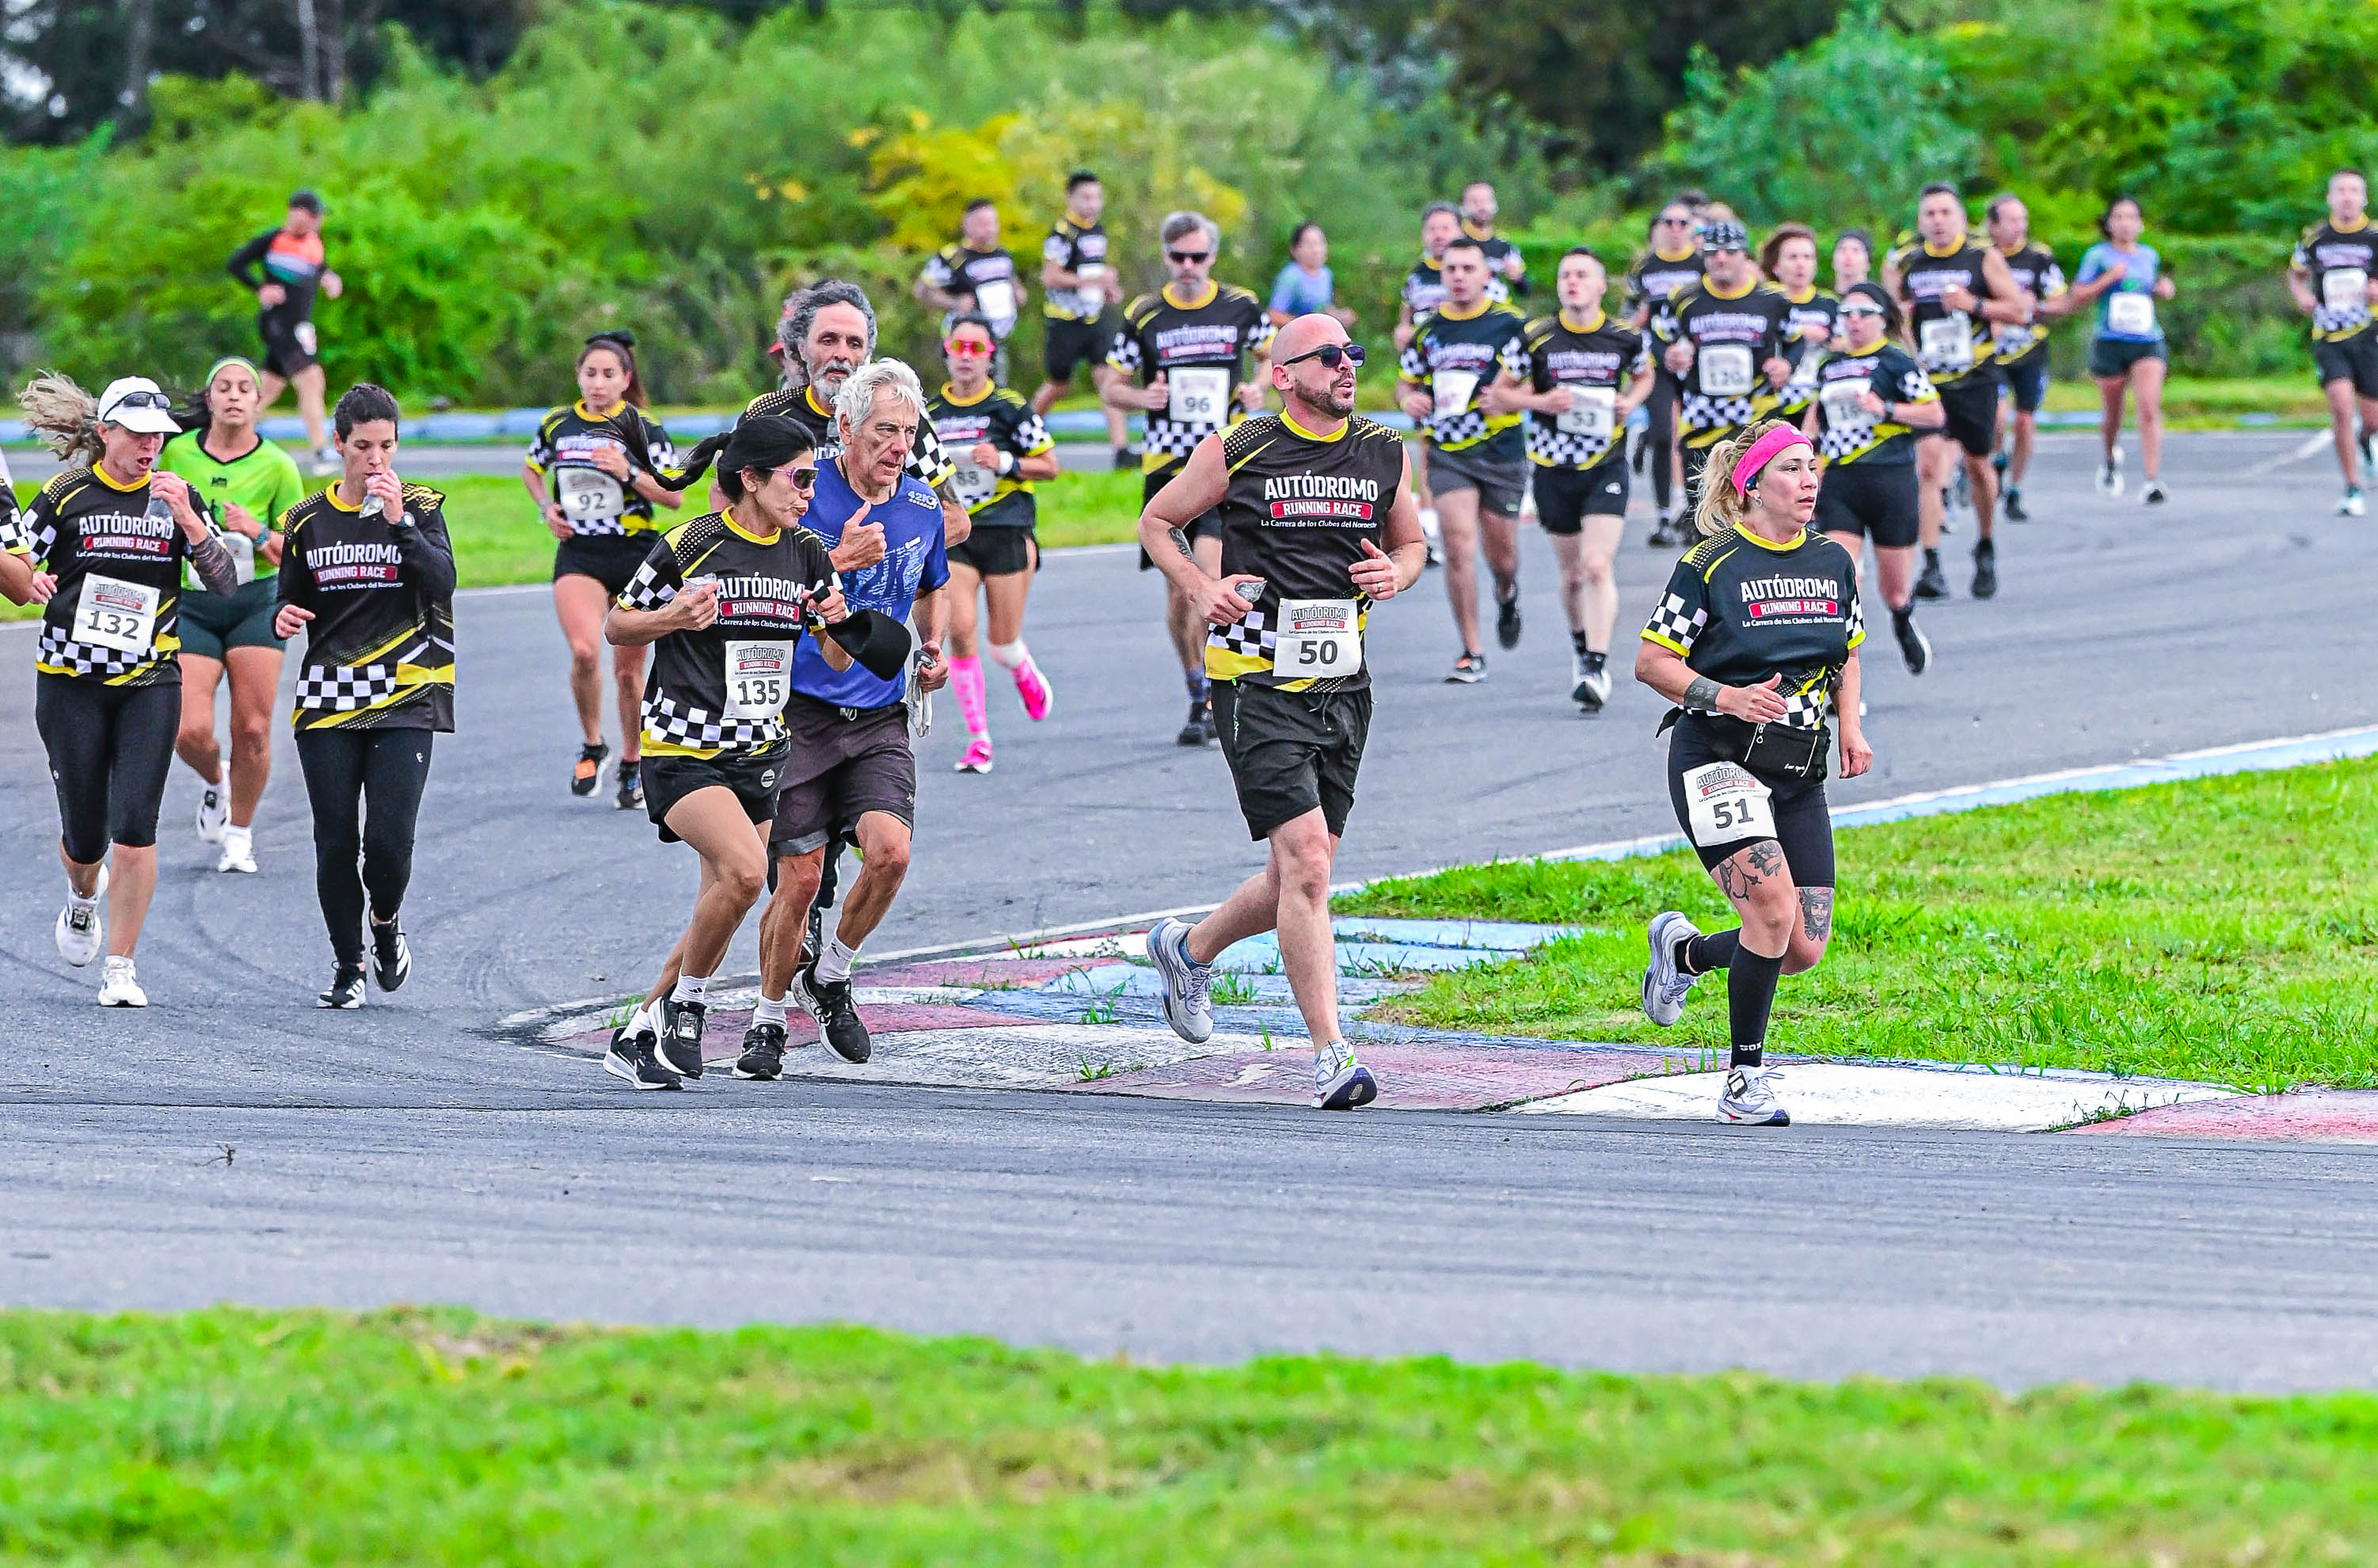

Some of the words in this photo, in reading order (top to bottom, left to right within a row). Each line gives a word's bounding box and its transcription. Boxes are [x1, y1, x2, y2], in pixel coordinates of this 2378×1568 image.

[1185, 397, 1211, 413] 96
[1265, 470, 1378, 501] AUTÓDROMO
[579, 493, 607, 511] 92
[1283, 501, 1330, 516] RUNNING
[1334, 503, 1362, 516] RACE
[79, 511, 174, 539] AUTÓDROMO
[93, 537, 135, 548] RUNNING
[135, 539, 161, 552] RACE
[306, 540, 402, 569] AUTÓDROMO
[360, 565, 386, 578] RACE
[717, 572, 805, 604] AUTÓDROM
[1740, 573, 1838, 602] AUTÓDROMO
[732, 601, 774, 615] RUNNING
[775, 603, 795, 619] RACE
[1291, 604, 1349, 621] AUTÓDROMO
[1760, 601, 1801, 615] RUNNING
[1803, 601, 1828, 613] RACE
[88, 611, 139, 641] 132
[761, 620, 779, 629] Clubes
[736, 645, 786, 662] AUTÓDROMO
[1299, 640, 1338, 664] 50
[737, 679, 781, 705] 135
[1697, 767, 1756, 790] AUTÓDROM
[1713, 798, 1754, 829] 51
